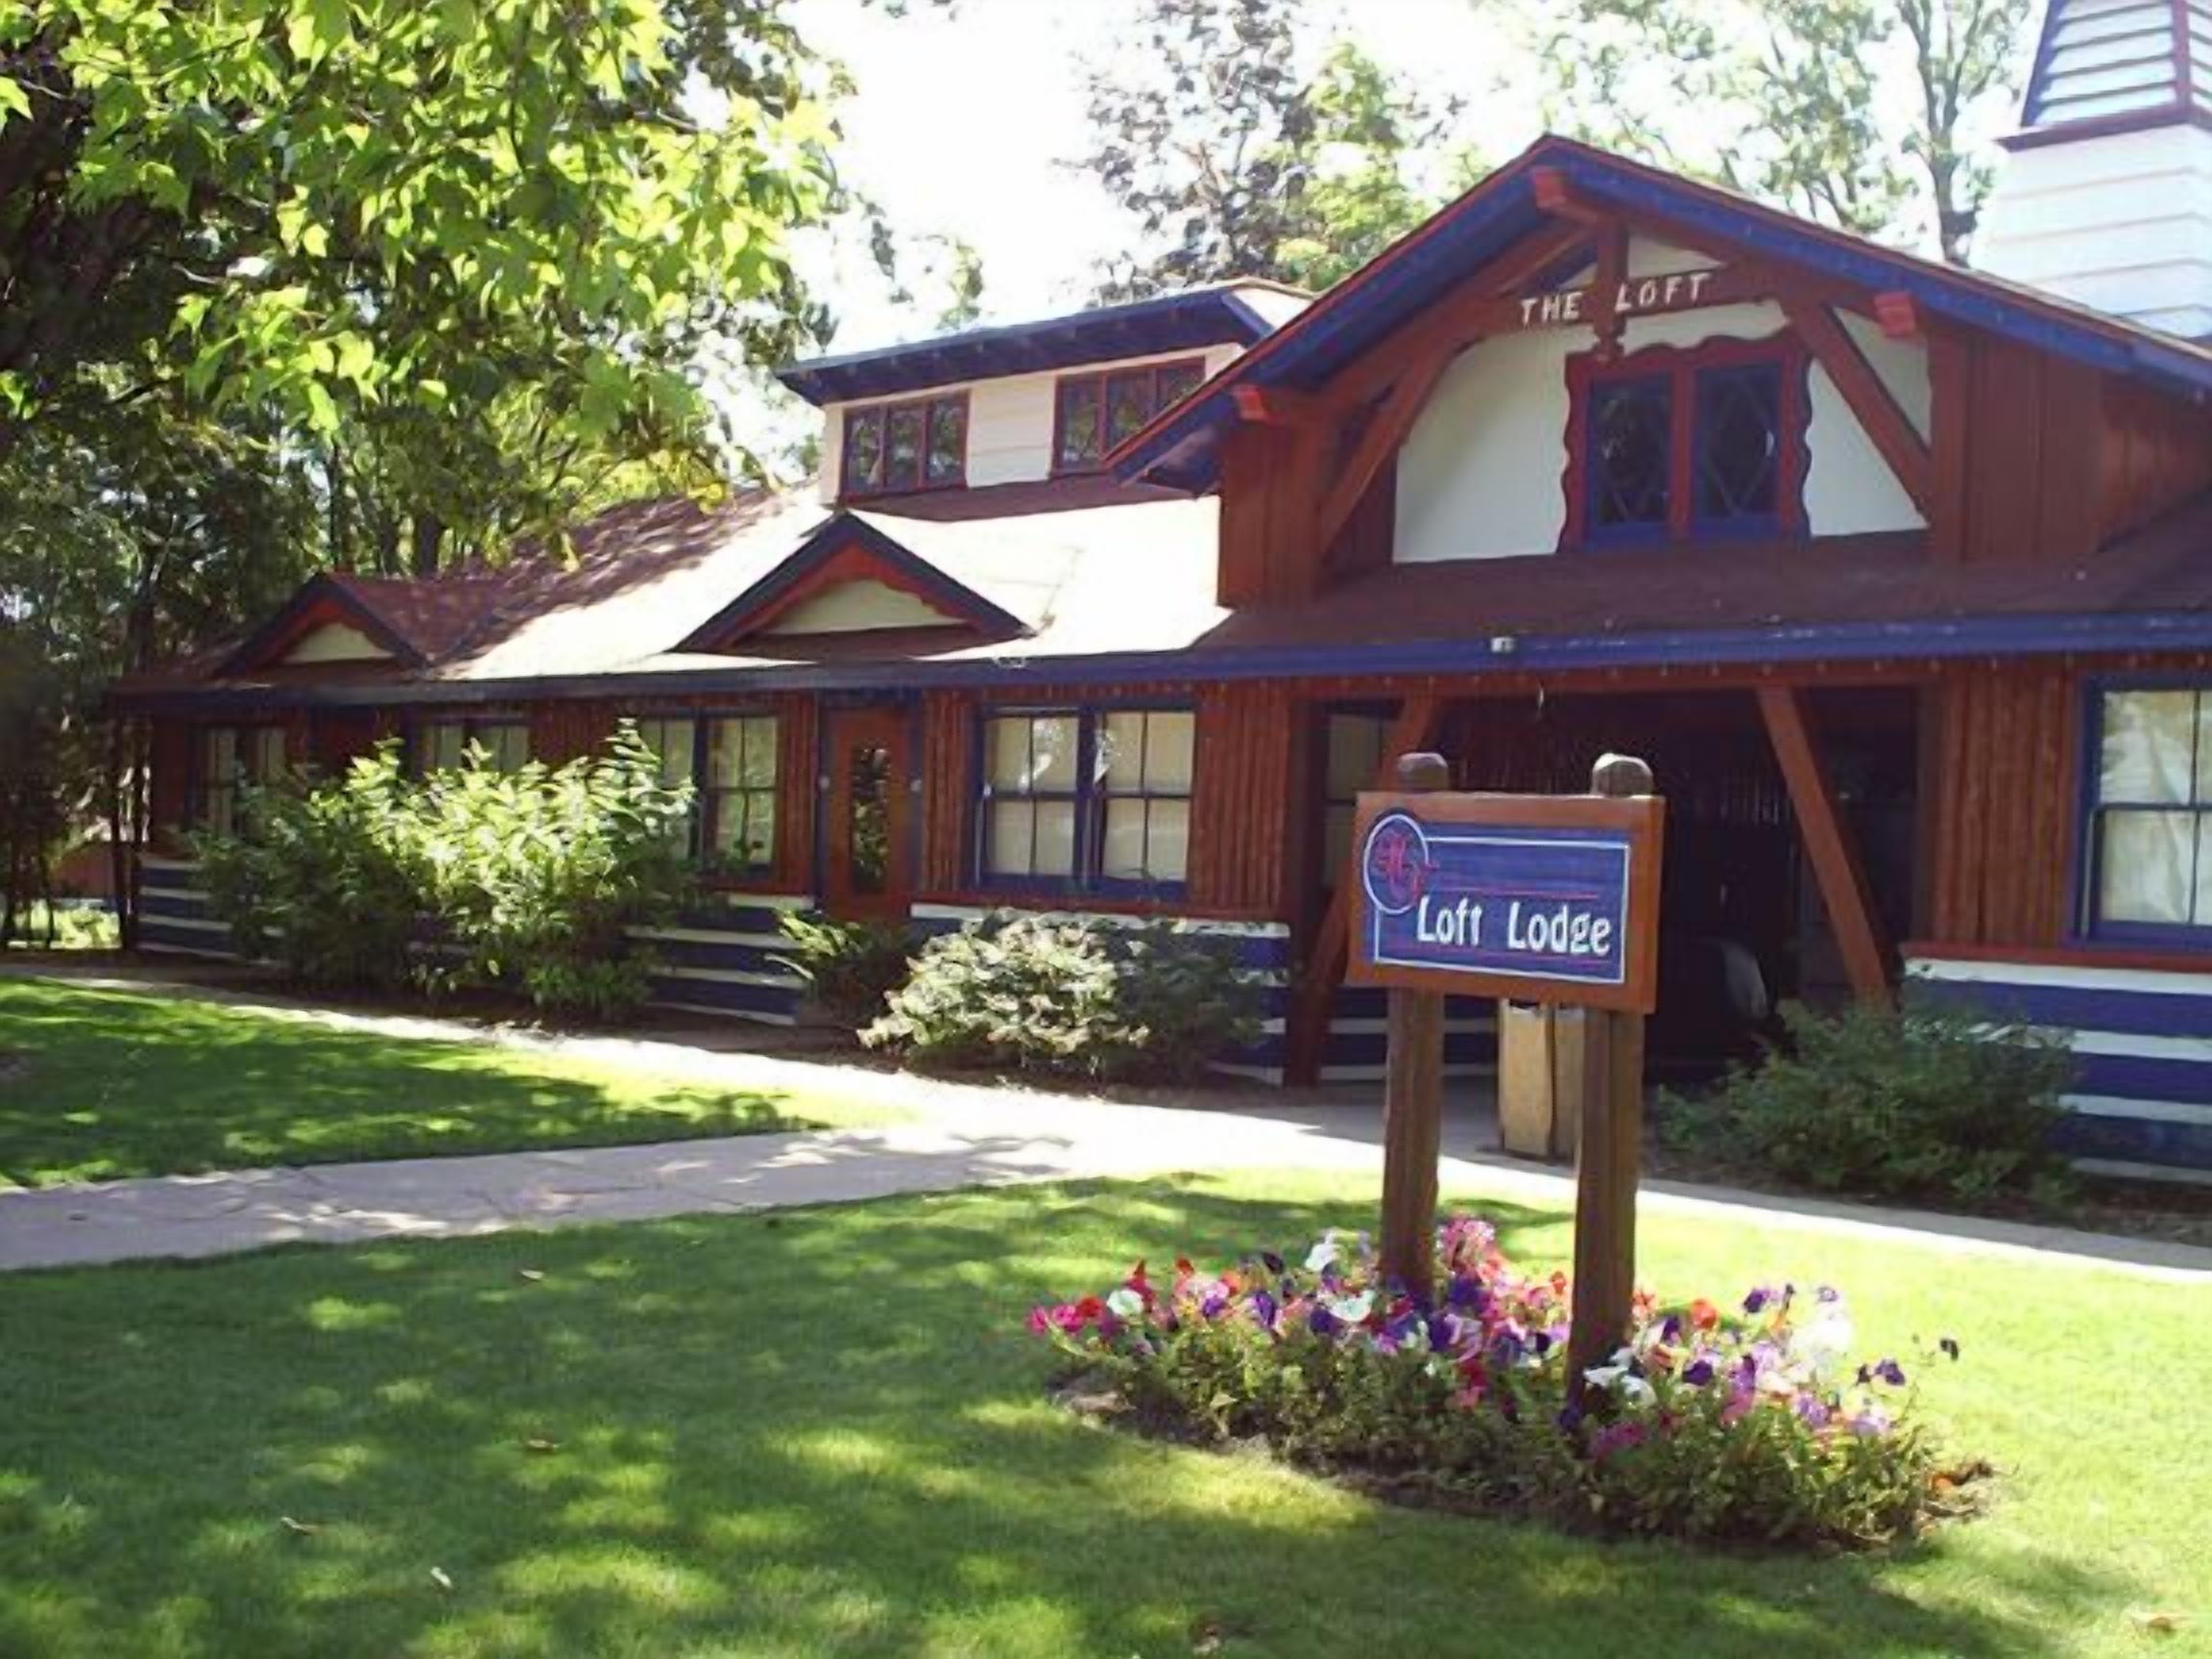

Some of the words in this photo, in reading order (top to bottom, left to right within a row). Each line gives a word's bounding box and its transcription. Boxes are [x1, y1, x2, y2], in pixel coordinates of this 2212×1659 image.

[1520, 291, 1582, 326] THE
[1614, 272, 1712, 313] LOFT
[1416, 894, 1482, 946] Loft
[1506, 901, 1612, 955] Lodge
